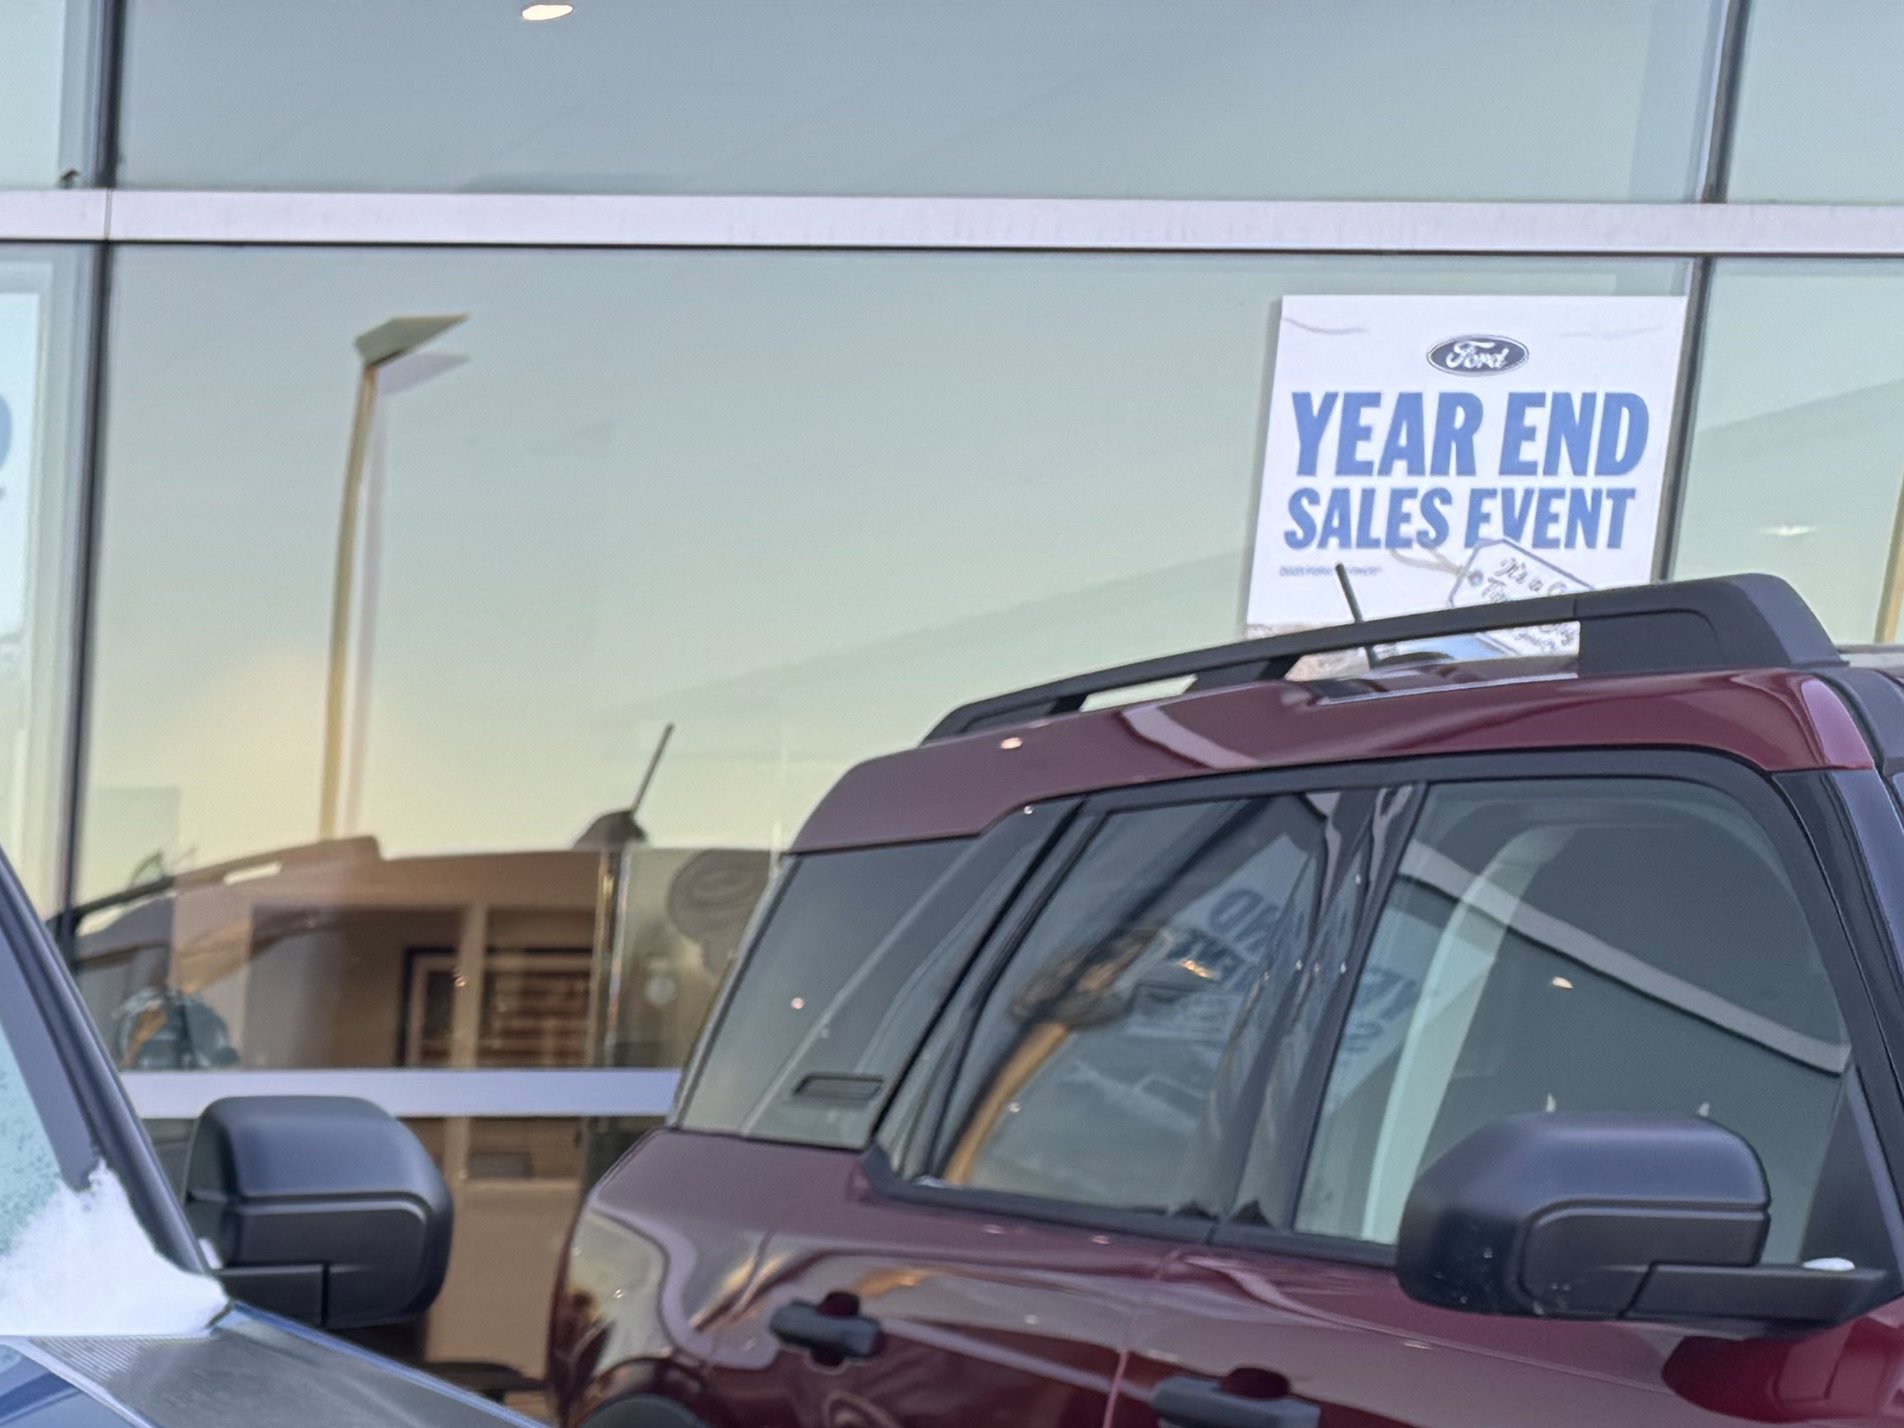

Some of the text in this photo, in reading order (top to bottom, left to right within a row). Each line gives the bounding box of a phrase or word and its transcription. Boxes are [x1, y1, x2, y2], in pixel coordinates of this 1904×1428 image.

[1446, 340, 1510, 370] Ford
[1291, 391, 1649, 477] YEAR END
[1283, 487, 1637, 550] SALES EVENT
